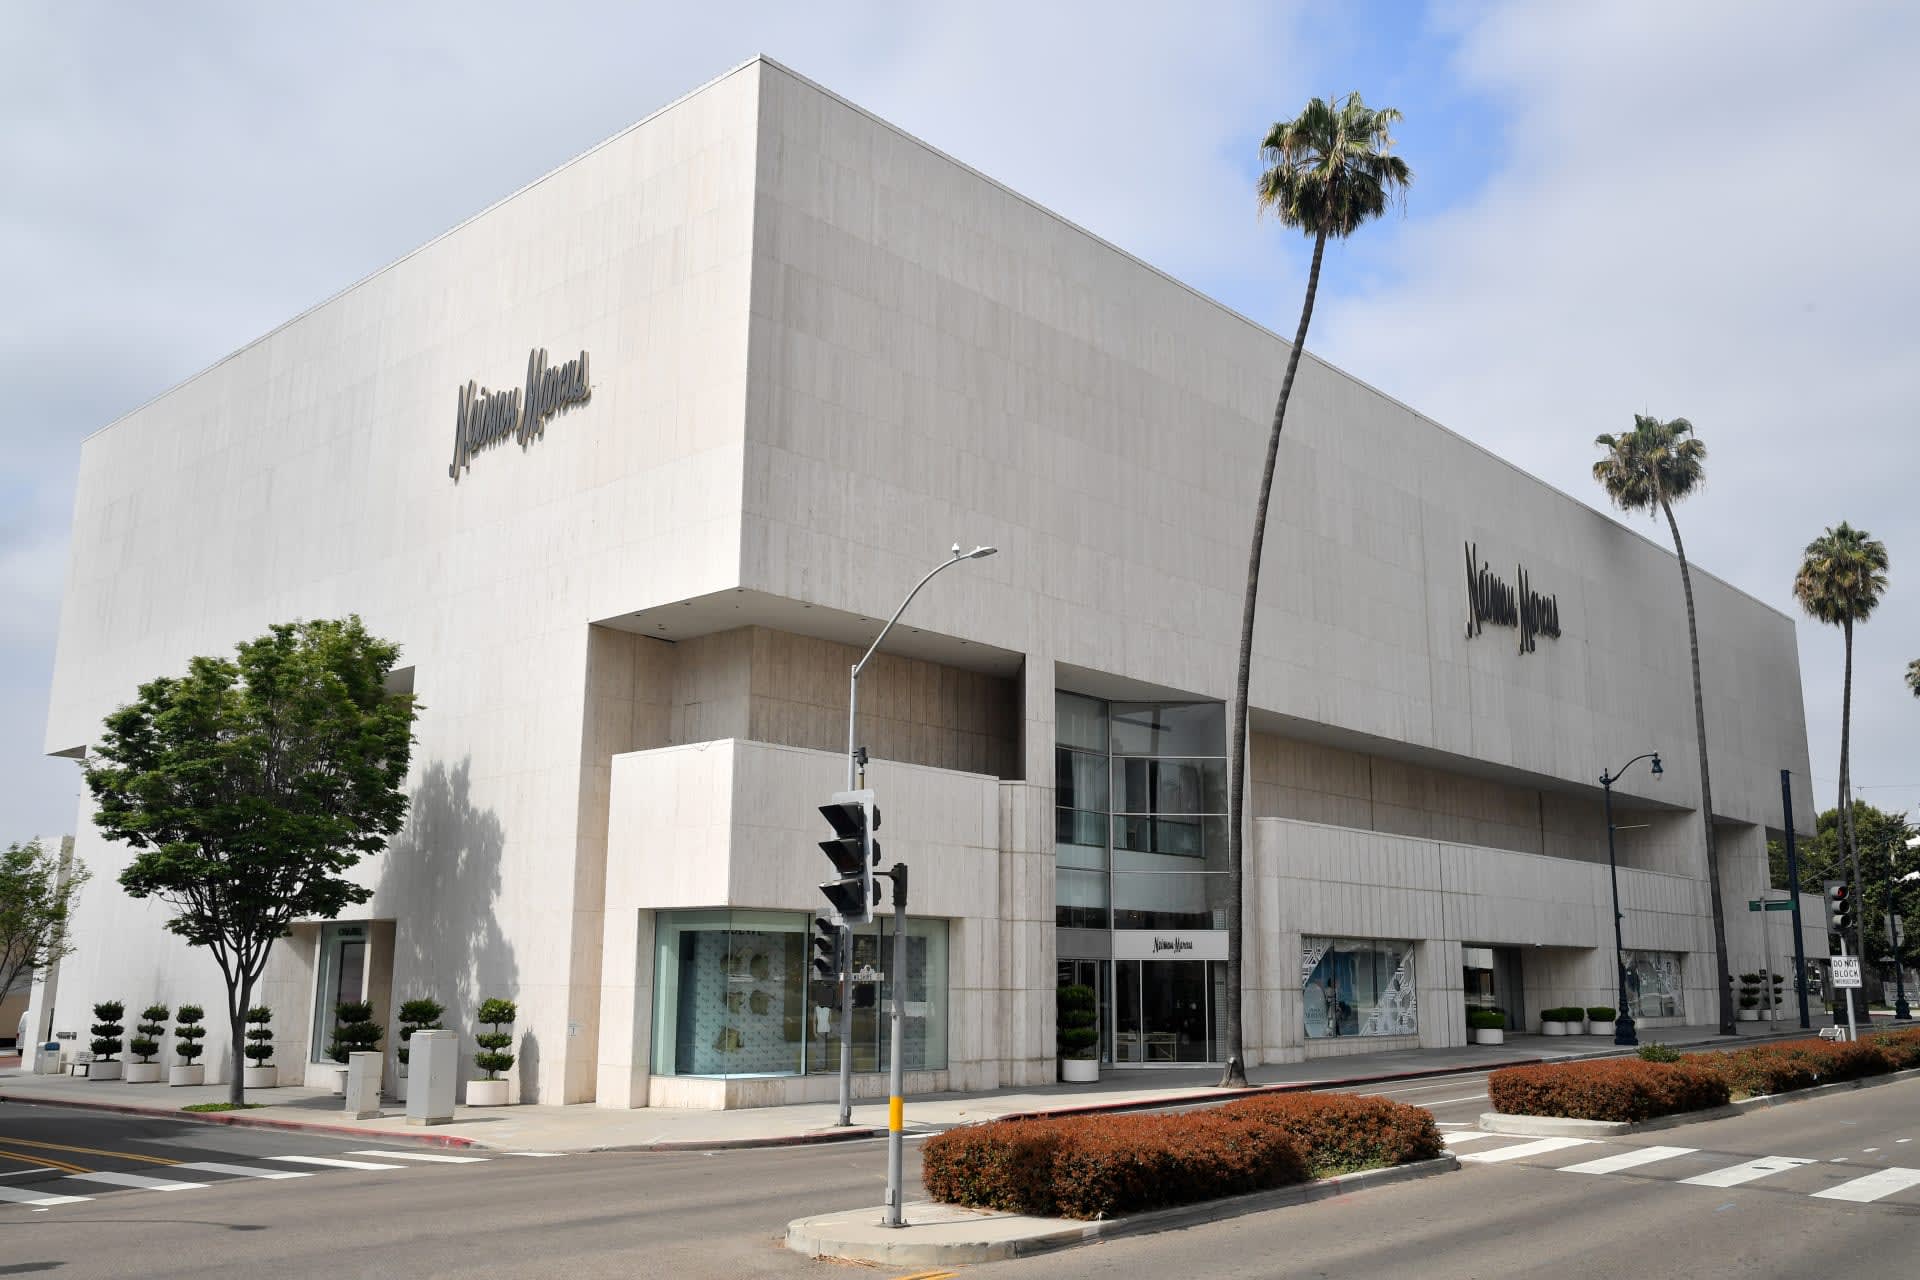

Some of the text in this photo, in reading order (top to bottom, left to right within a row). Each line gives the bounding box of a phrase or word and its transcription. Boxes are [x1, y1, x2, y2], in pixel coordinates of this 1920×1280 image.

[449, 348, 592, 480] Neiman Marcus
[1465, 540, 1561, 655] Neiman Marcus
[1833, 960, 1857, 969] DO NOT
[1834, 969, 1859, 978] BLOCK
